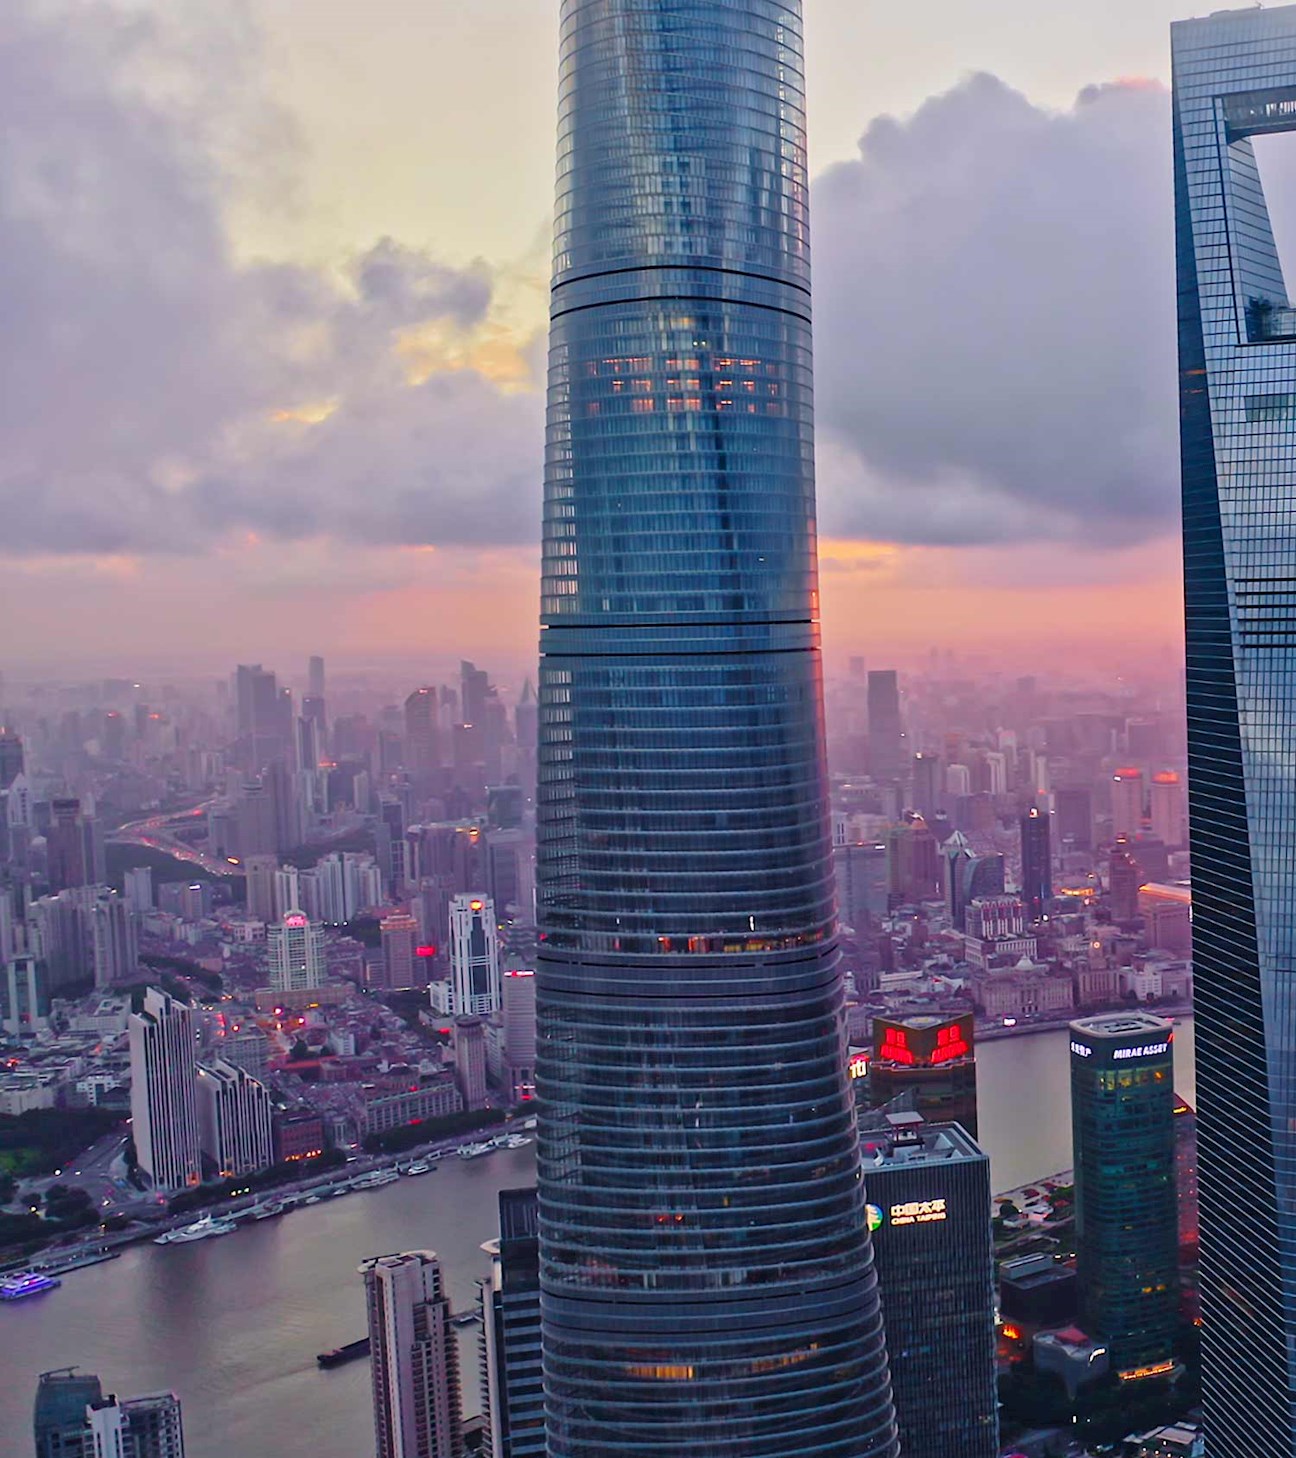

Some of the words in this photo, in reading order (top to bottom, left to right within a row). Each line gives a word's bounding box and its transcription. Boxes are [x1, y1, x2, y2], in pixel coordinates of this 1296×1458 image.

[1113, 1046, 1142, 1059] MIRAE
[1143, 1043, 1168, 1056] ASSET
[890, 1198, 946, 1217] 中国太平
